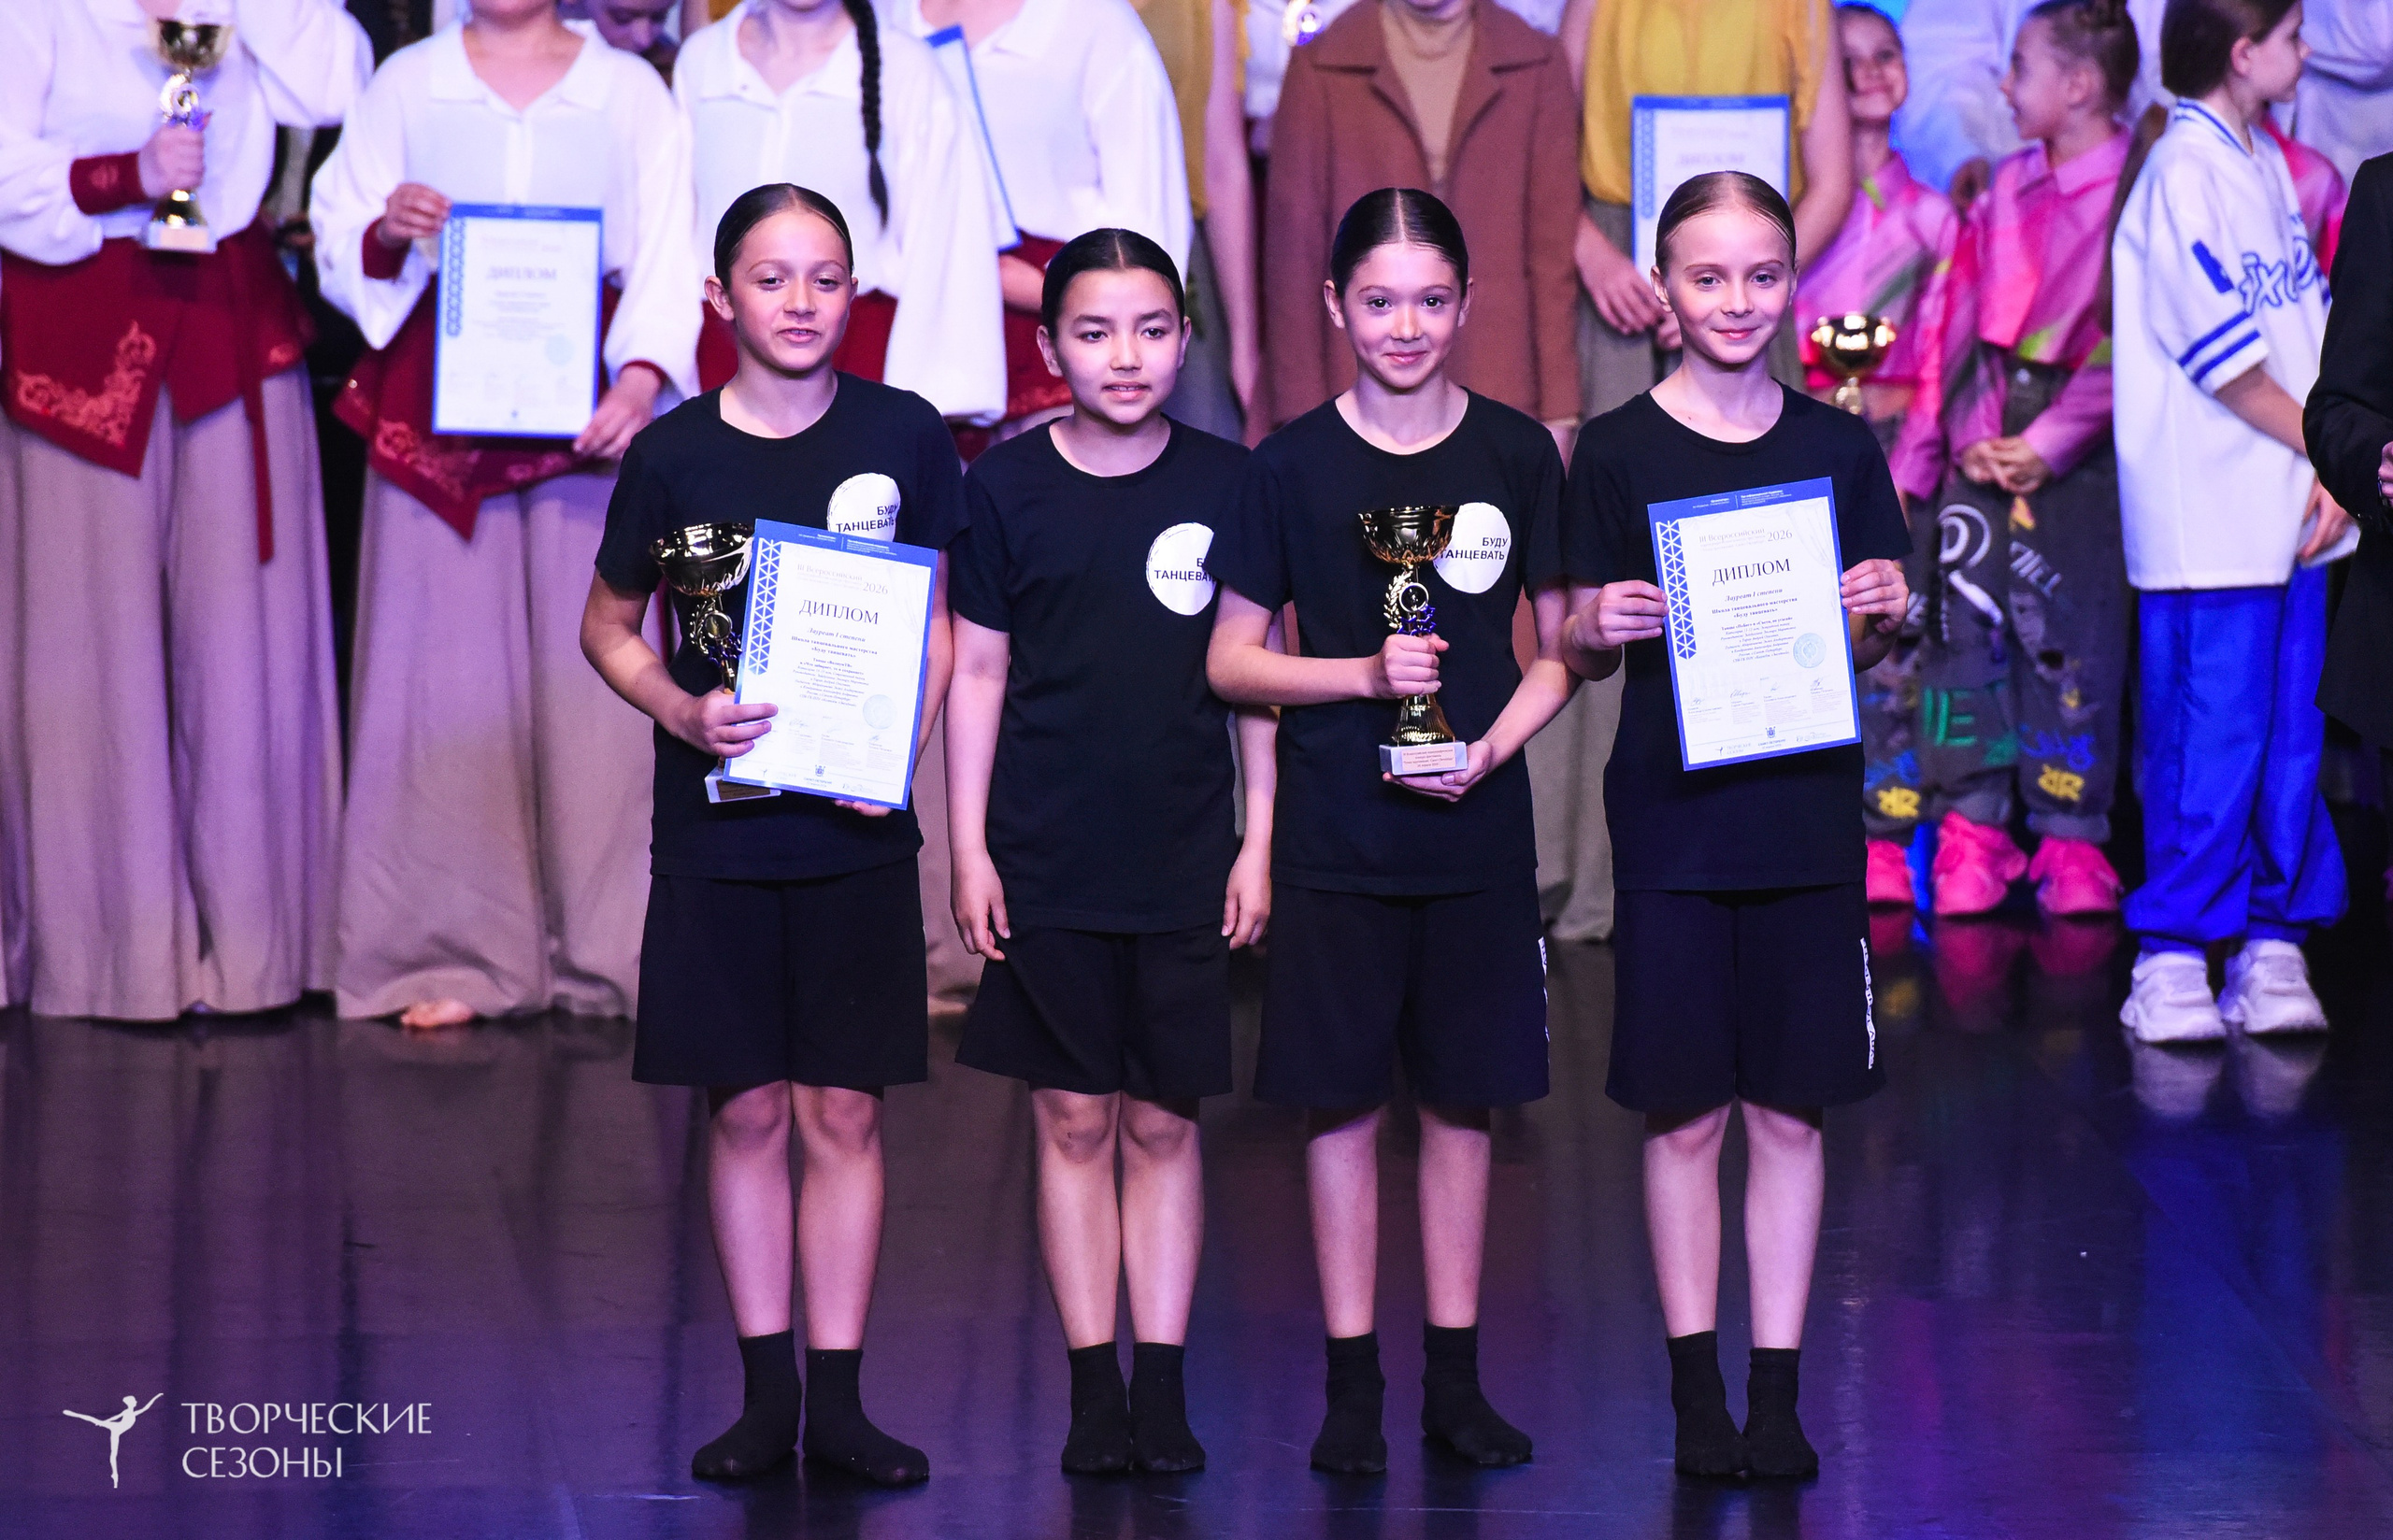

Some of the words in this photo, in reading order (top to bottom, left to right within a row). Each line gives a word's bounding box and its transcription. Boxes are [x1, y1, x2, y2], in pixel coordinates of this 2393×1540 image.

[877, 503, 899, 516] БУДУ
[836, 517, 895, 533] ТАНЦЕВАТЬ
[1482, 536, 1509, 548] БУДУ
[1767, 529, 1793, 542] 2026
[1712, 559, 1791, 586] ДИПЛОМ
[863, 581, 888, 595] 2026
[1725, 592, 1752, 603] Лауреат
[799, 599, 879, 625] ДИПЛОМ
